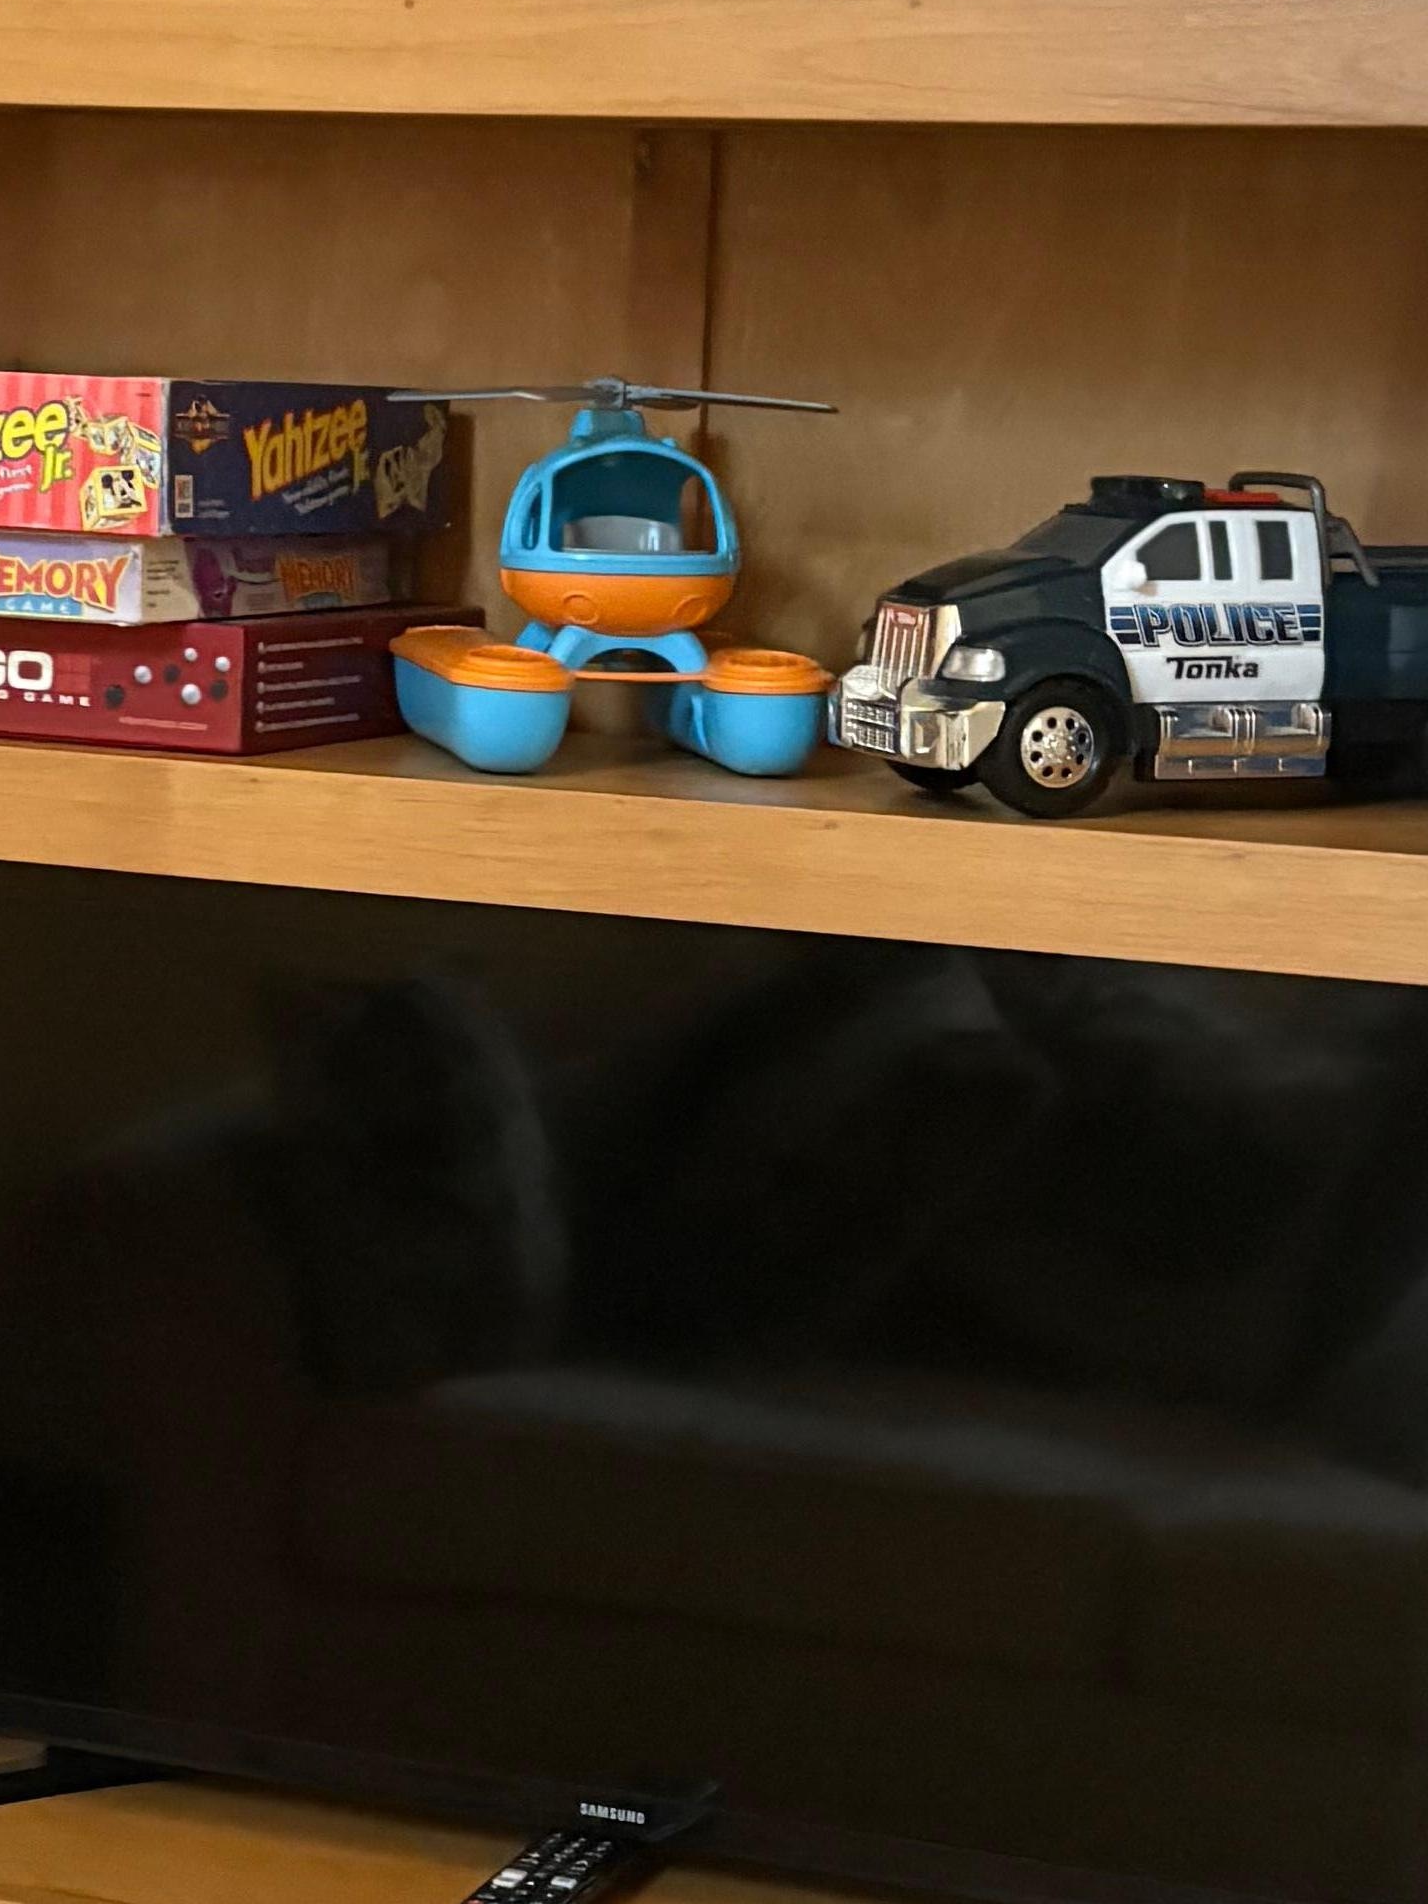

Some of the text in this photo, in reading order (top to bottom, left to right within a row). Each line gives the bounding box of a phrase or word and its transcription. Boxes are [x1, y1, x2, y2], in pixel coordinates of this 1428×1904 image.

[244, 399, 369, 503] Yahtzee
[38, 447, 73, 492] Jr.
[280, 554, 360, 595] MEMORY
[5, 599, 70, 615] GAME
[1132, 603, 1305, 649] POLICE
[1165, 655, 1260, 682] Tonka
[24, 690, 92, 708] GAME
[580, 1802, 645, 1825] SAMSUNG
